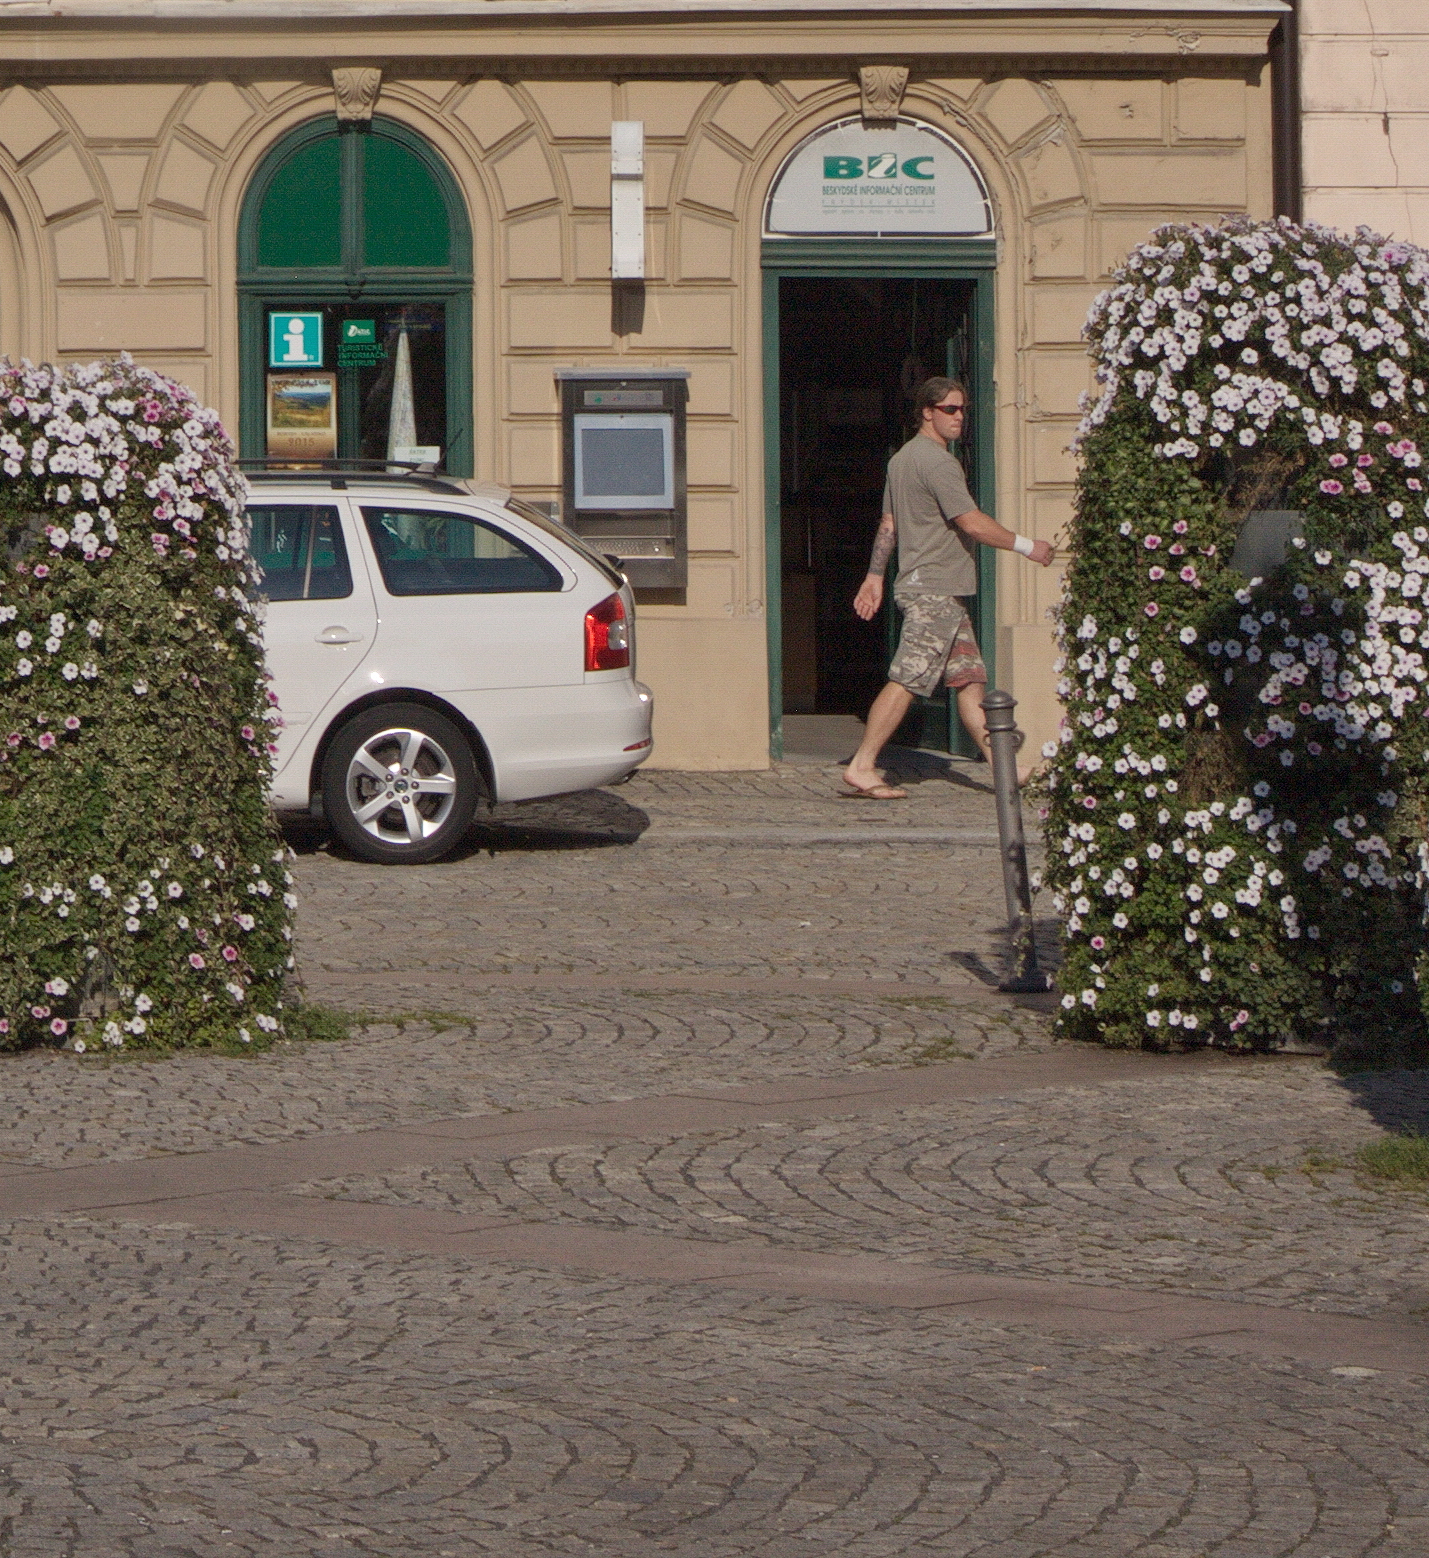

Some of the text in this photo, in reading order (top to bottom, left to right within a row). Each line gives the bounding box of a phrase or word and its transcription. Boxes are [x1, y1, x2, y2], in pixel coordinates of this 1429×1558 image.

[822, 184, 935, 196] BESKYDSKÉ INFORMAČNÍ CENTRUM
